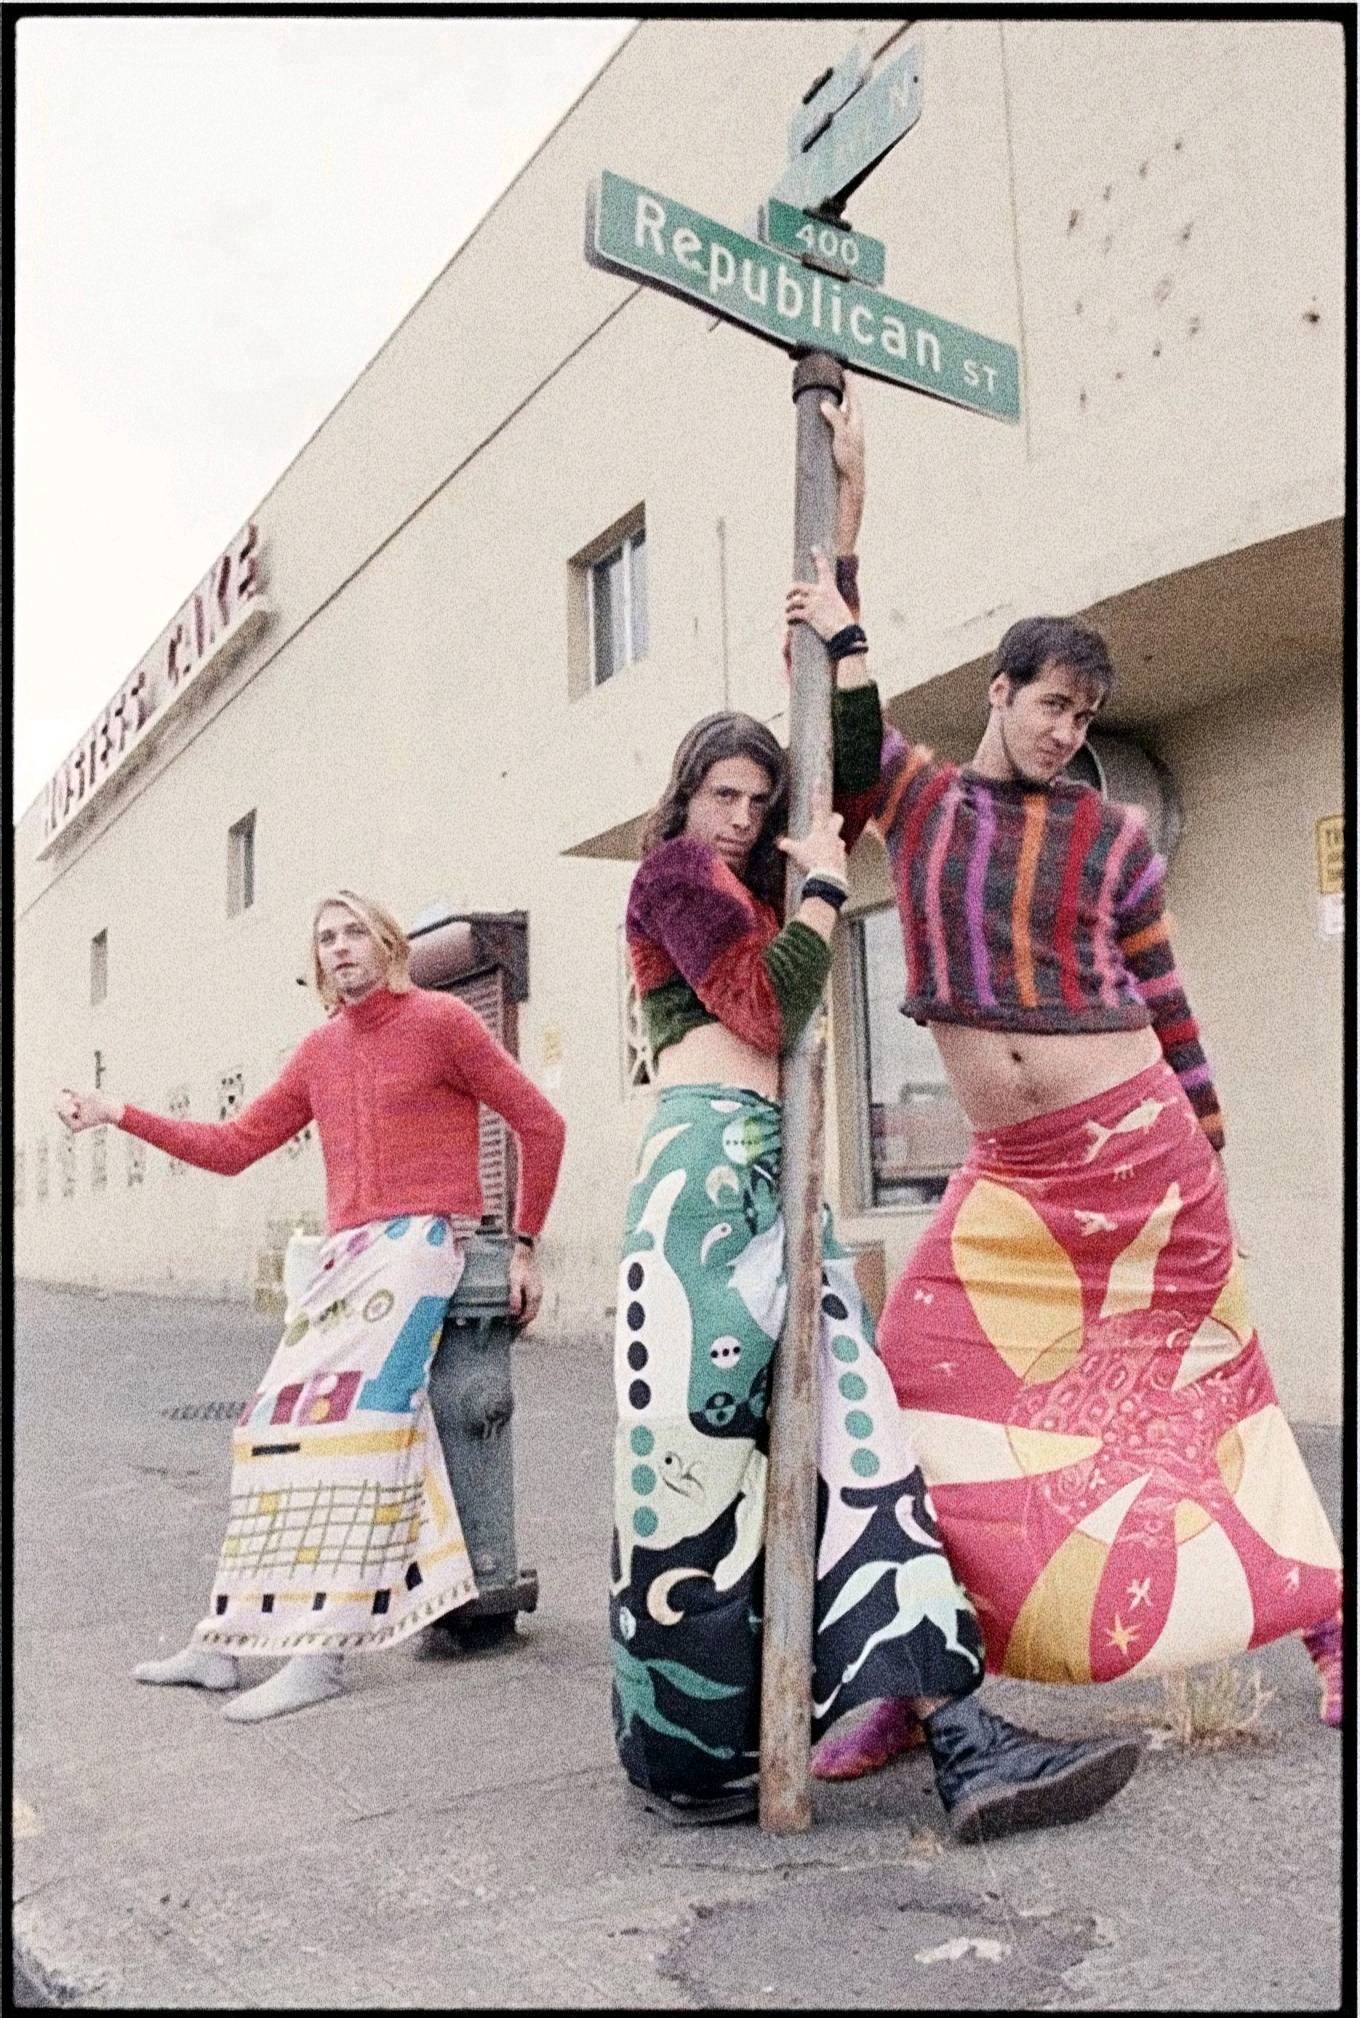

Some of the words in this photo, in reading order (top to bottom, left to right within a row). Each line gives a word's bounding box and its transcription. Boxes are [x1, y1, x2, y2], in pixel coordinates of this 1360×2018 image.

[633, 195, 942, 373] Republican
[962, 358, 998, 395] ST
[796, 223, 860, 266] 400
